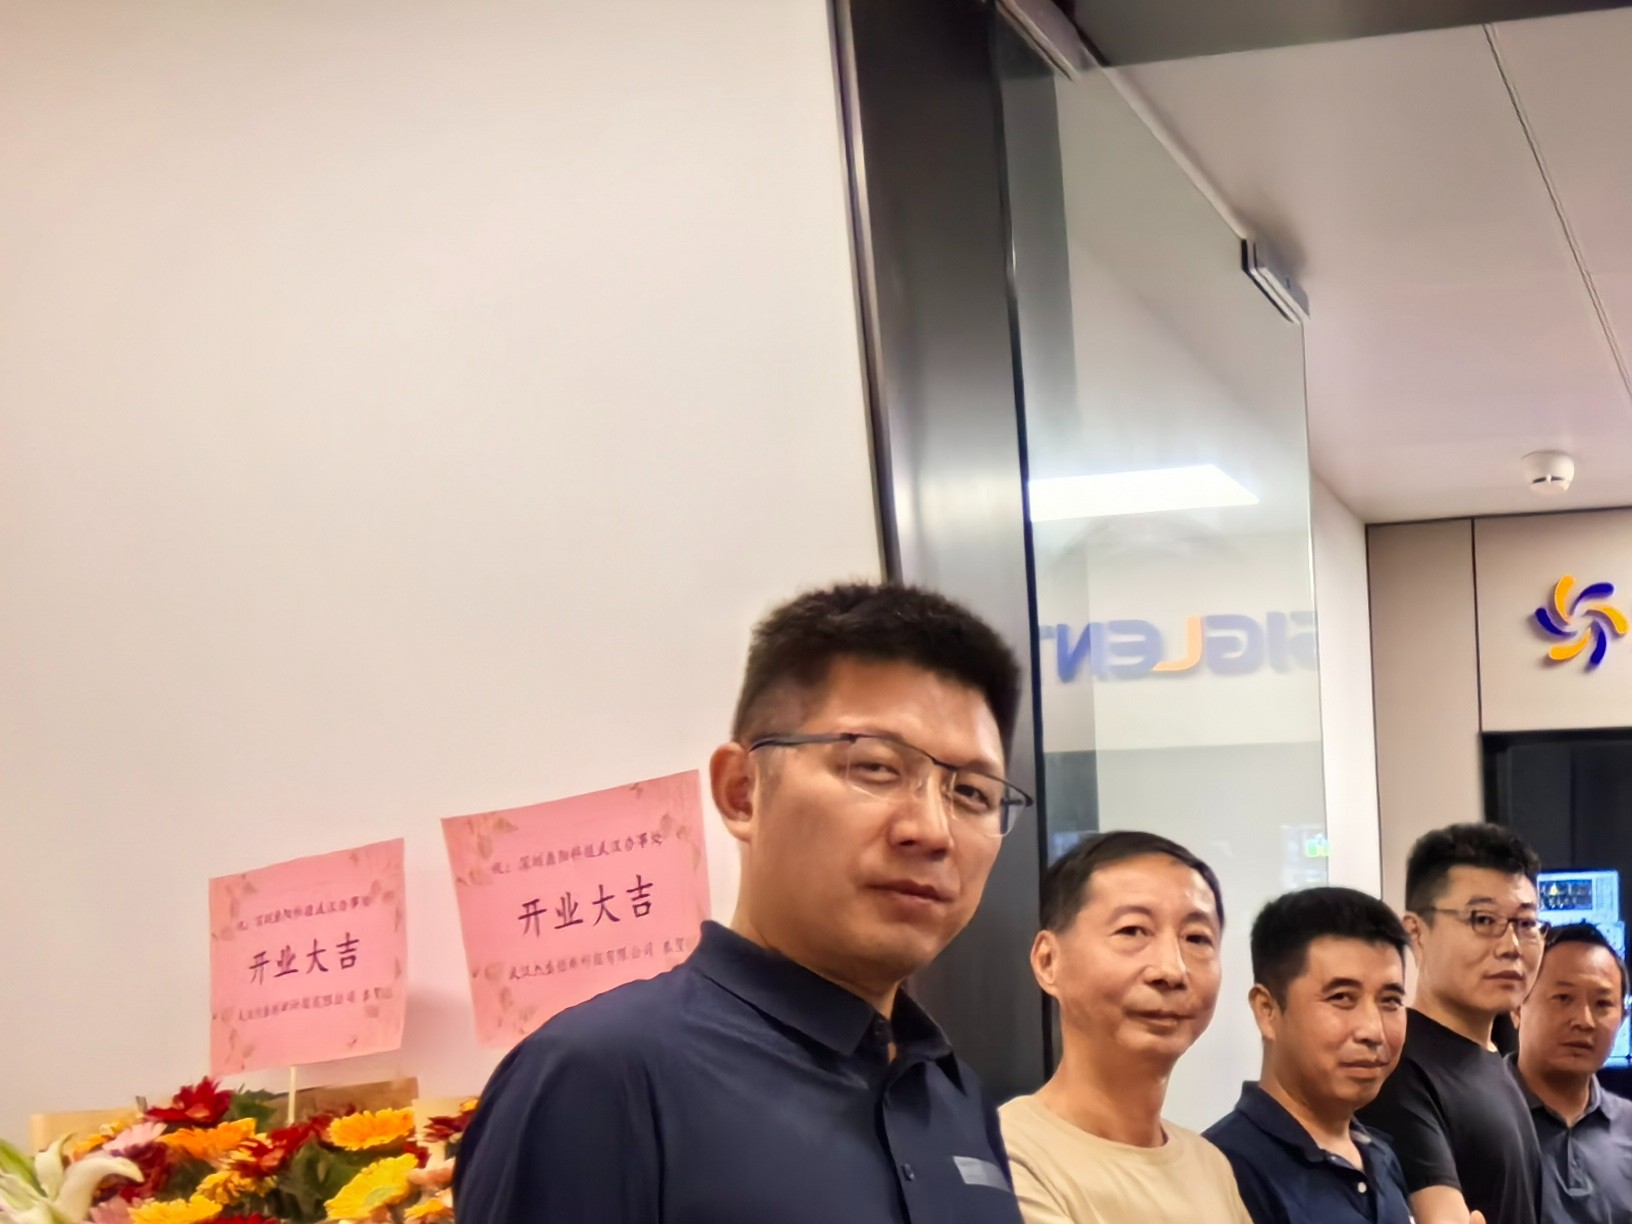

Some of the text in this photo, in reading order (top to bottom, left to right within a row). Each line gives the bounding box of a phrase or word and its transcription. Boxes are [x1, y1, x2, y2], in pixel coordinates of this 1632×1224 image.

[517, 873, 654, 938] 开业大吉
[248, 931, 360, 986] 开业大吉
